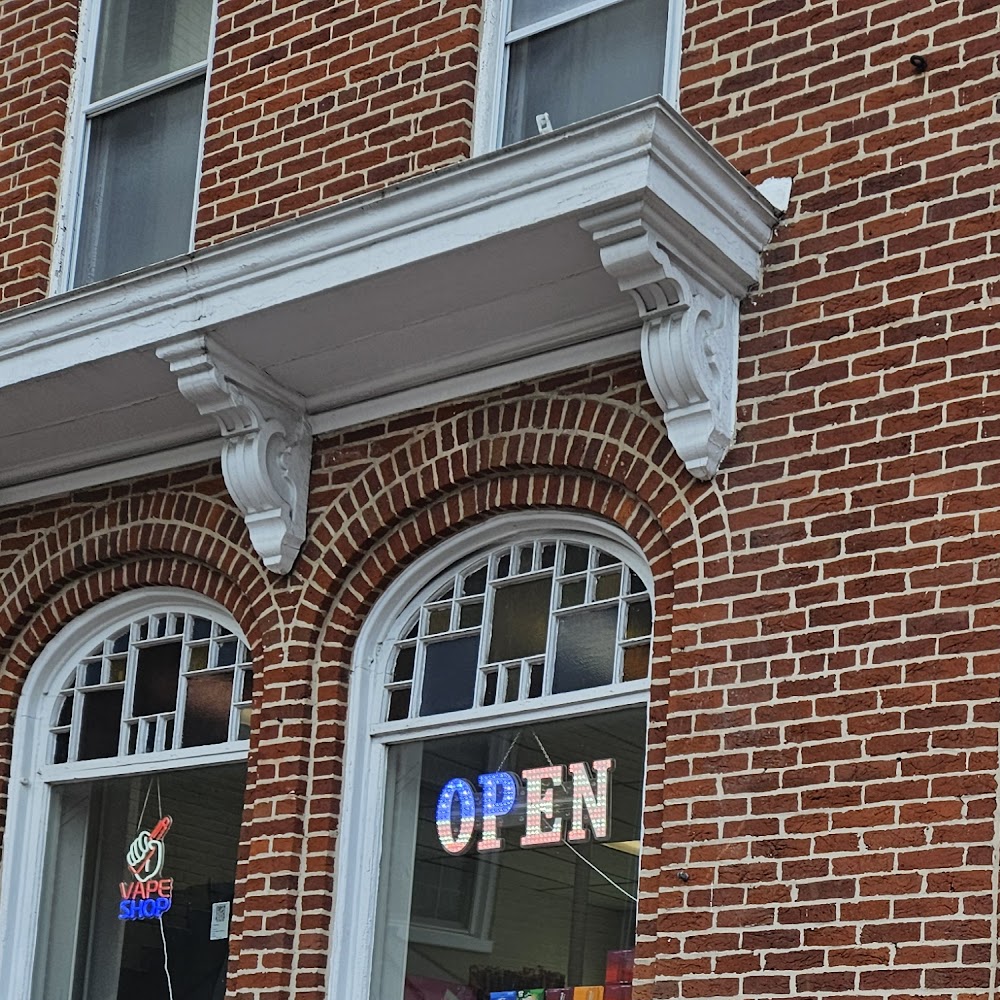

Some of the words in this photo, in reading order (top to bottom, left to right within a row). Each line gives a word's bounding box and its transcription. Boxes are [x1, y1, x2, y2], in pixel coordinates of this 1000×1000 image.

[436, 758, 614, 854] OPEN
[119, 878, 173, 899] VAPE
[118, 897, 171, 920] SHOP
